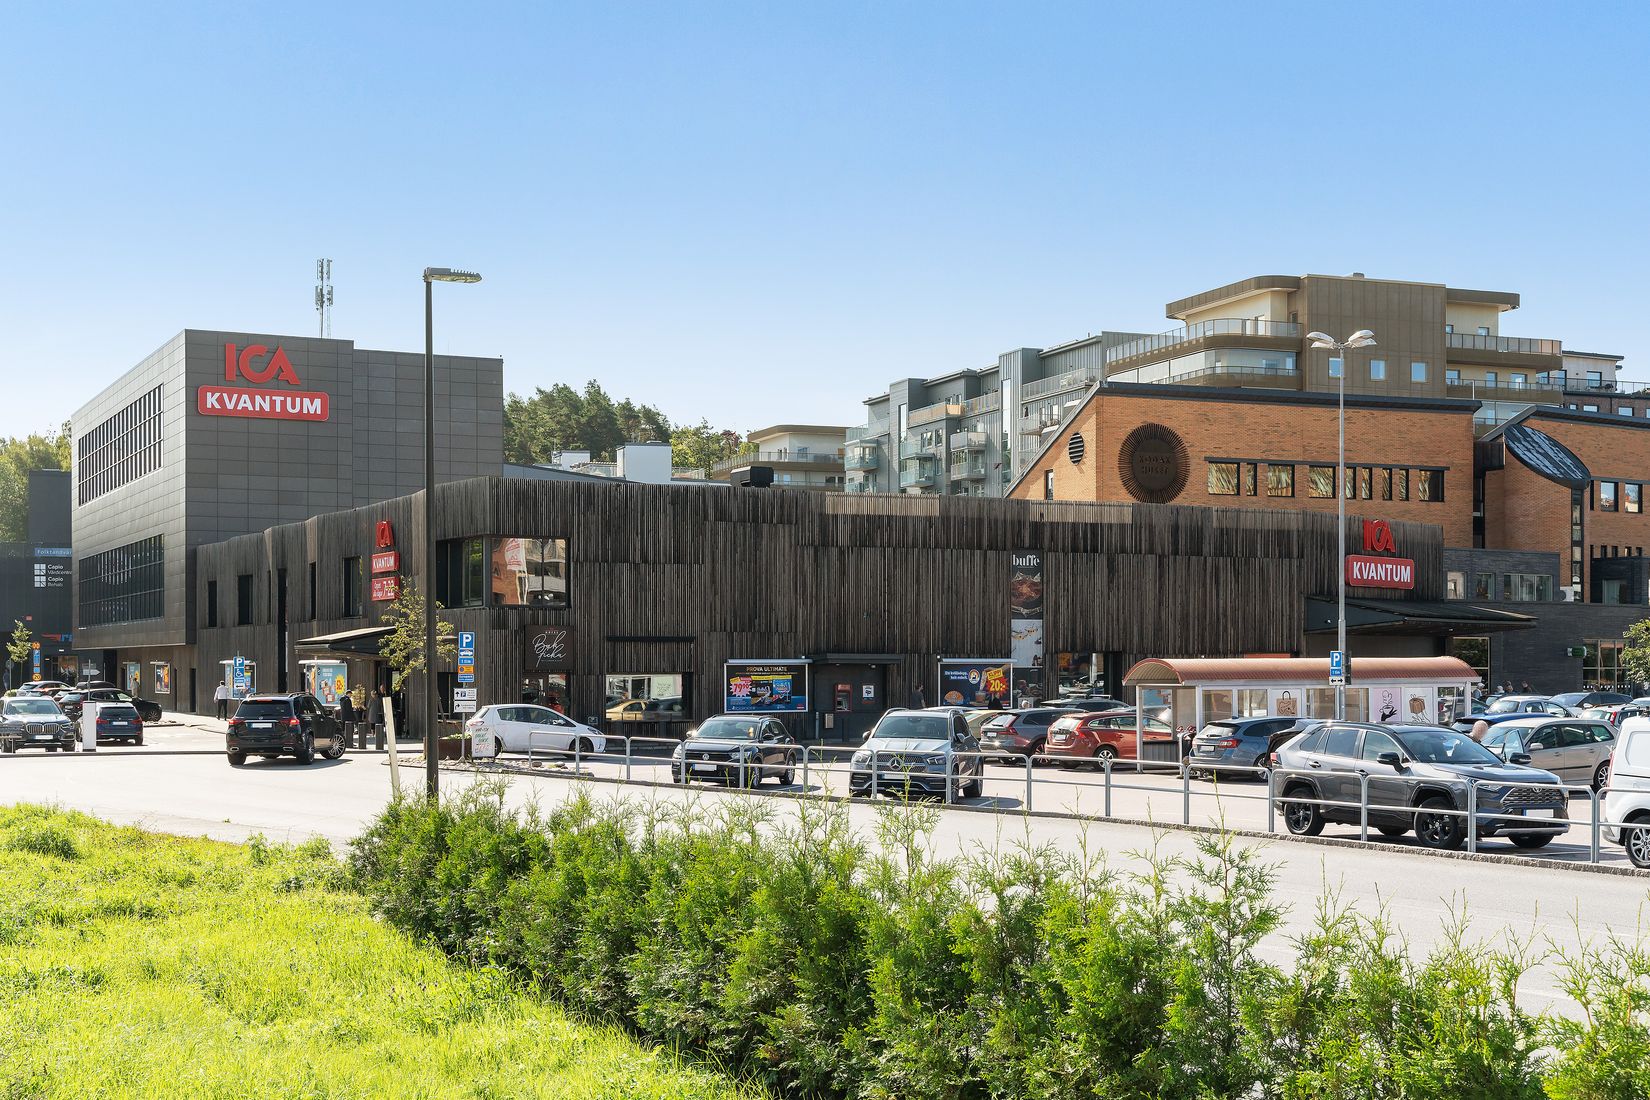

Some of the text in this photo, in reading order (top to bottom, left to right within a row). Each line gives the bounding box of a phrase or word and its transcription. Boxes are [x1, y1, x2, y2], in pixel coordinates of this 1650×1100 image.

[225, 343, 300, 385] ICA
[206, 392, 321, 415] KVANTUM
[1139, 455, 1171, 464] KODAK
[1363, 519, 1395, 552] ICA
[373, 555, 394, 569] KVANTUM
[1353, 561, 1410, 583] KVANTUM
[463, 634, 471, 647] P
[236, 658, 242, 666] P
[1333, 653, 1340, 667] P
[990, 680, 1006, 691] 20:-
